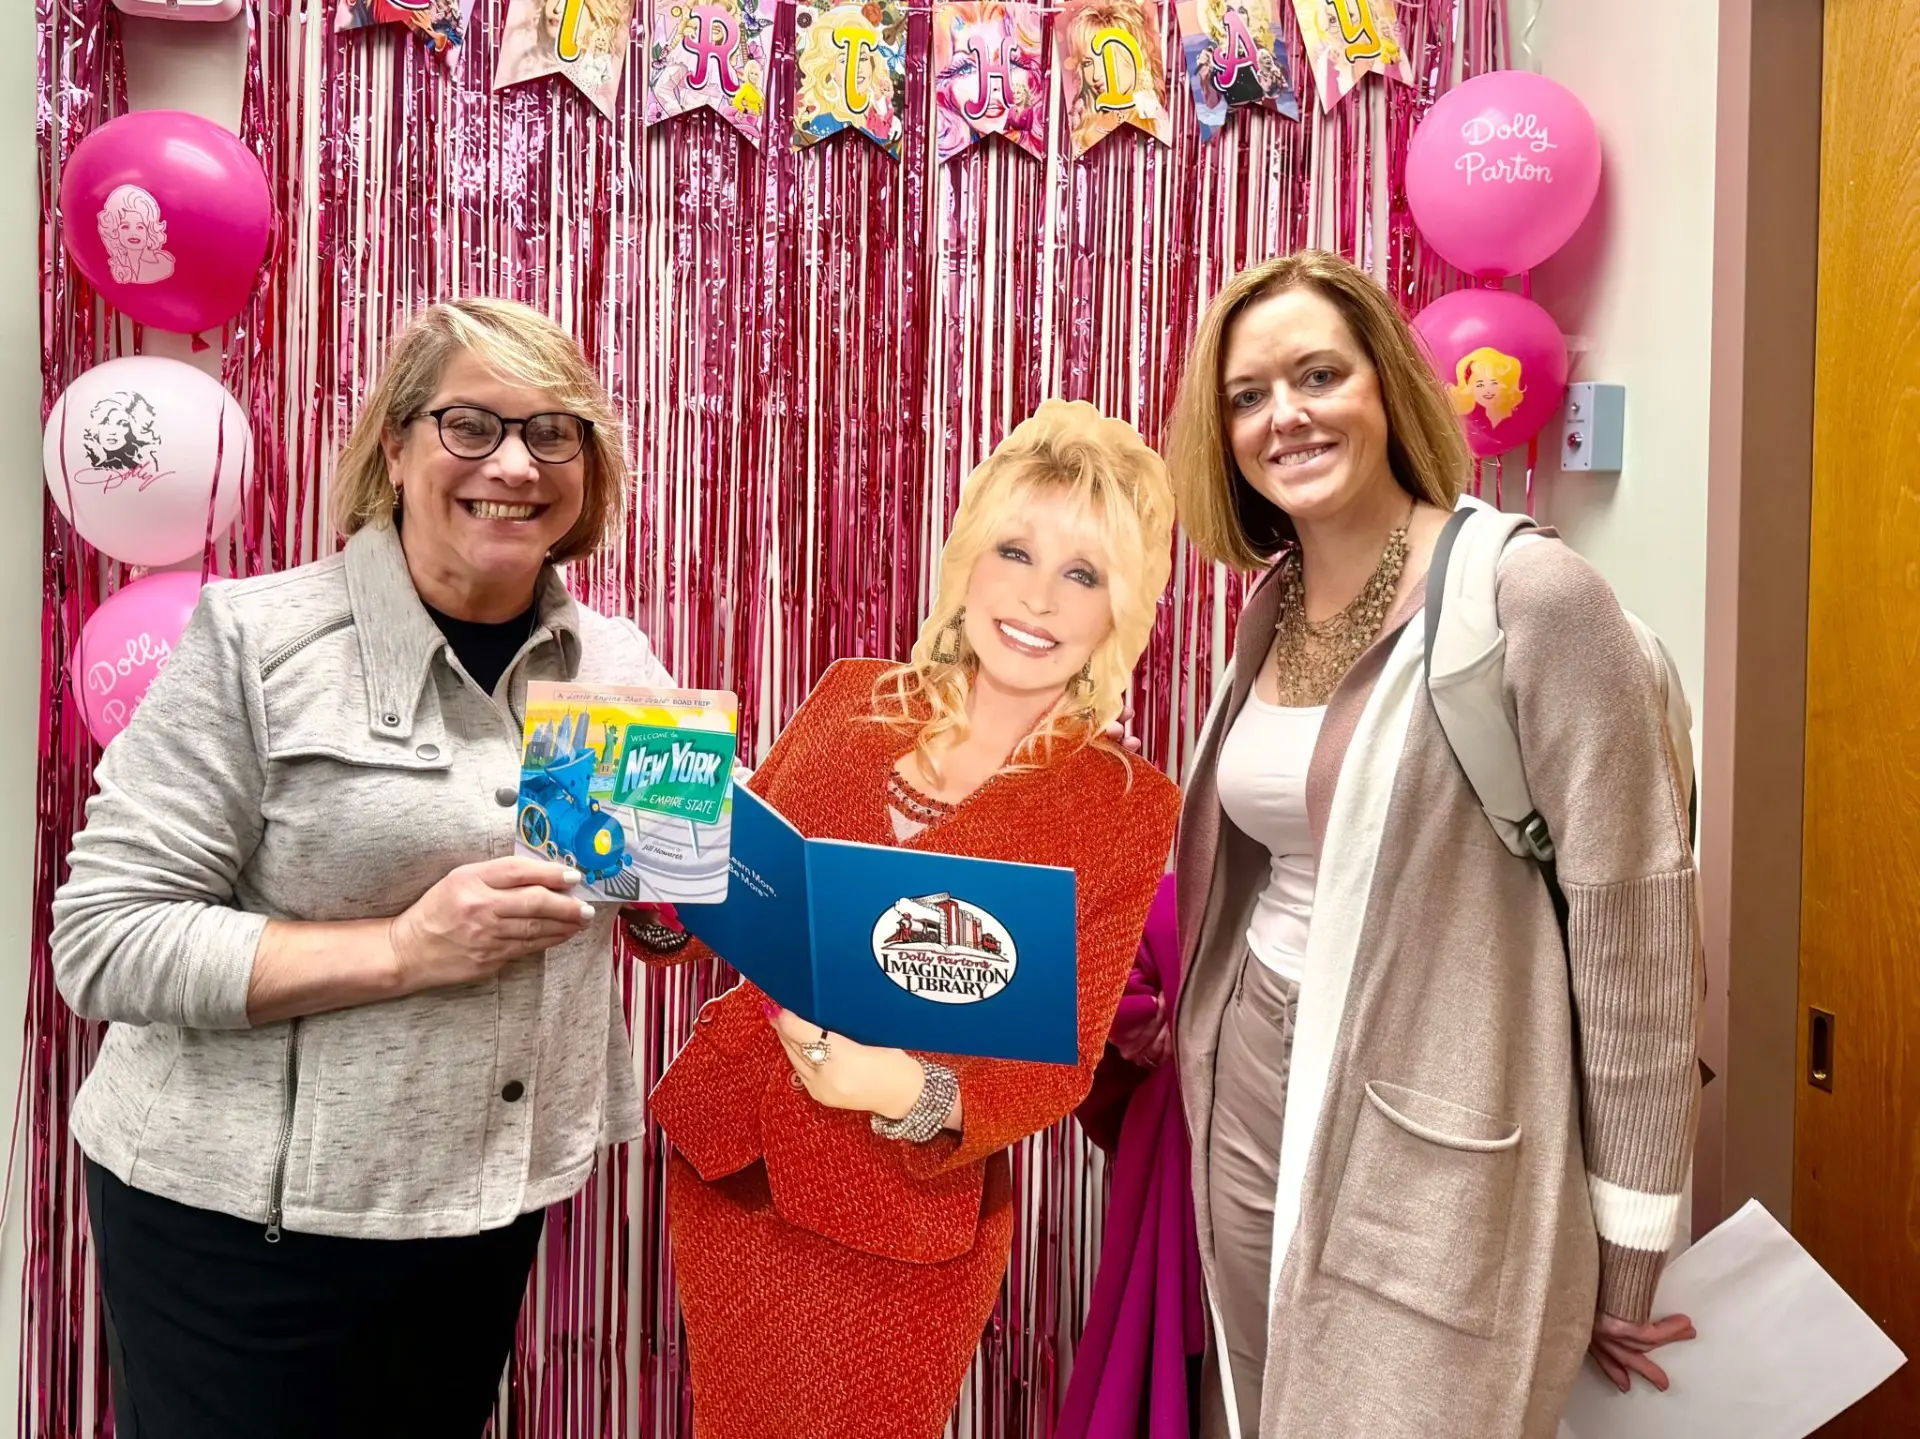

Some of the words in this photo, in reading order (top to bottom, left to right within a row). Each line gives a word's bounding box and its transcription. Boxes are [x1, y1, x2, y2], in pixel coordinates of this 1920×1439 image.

[387, 0, 1383, 120] IRTHDAY
[1461, 113, 1558, 152] Dolly
[1454, 152, 1554, 185] Parton
[74, 461, 176, 494] Dolly
[88, 632, 173, 696] Dolly
[672, 698, 692, 706] ROAD
[693, 699, 711, 707] TRIP
[630, 732, 668, 742] WELCOME
[621, 746, 670, 793] NEW
[668, 742, 722, 788] YORK
[649, 794, 684, 809] EMPIRE
[685, 799, 716, 815] STATE
[729, 856, 751, 876] earn
[881, 953, 1009, 985] IMAGINATION
[898, 951, 935, 965] Dolly
[905, 975, 988, 1001] LIBRARY
